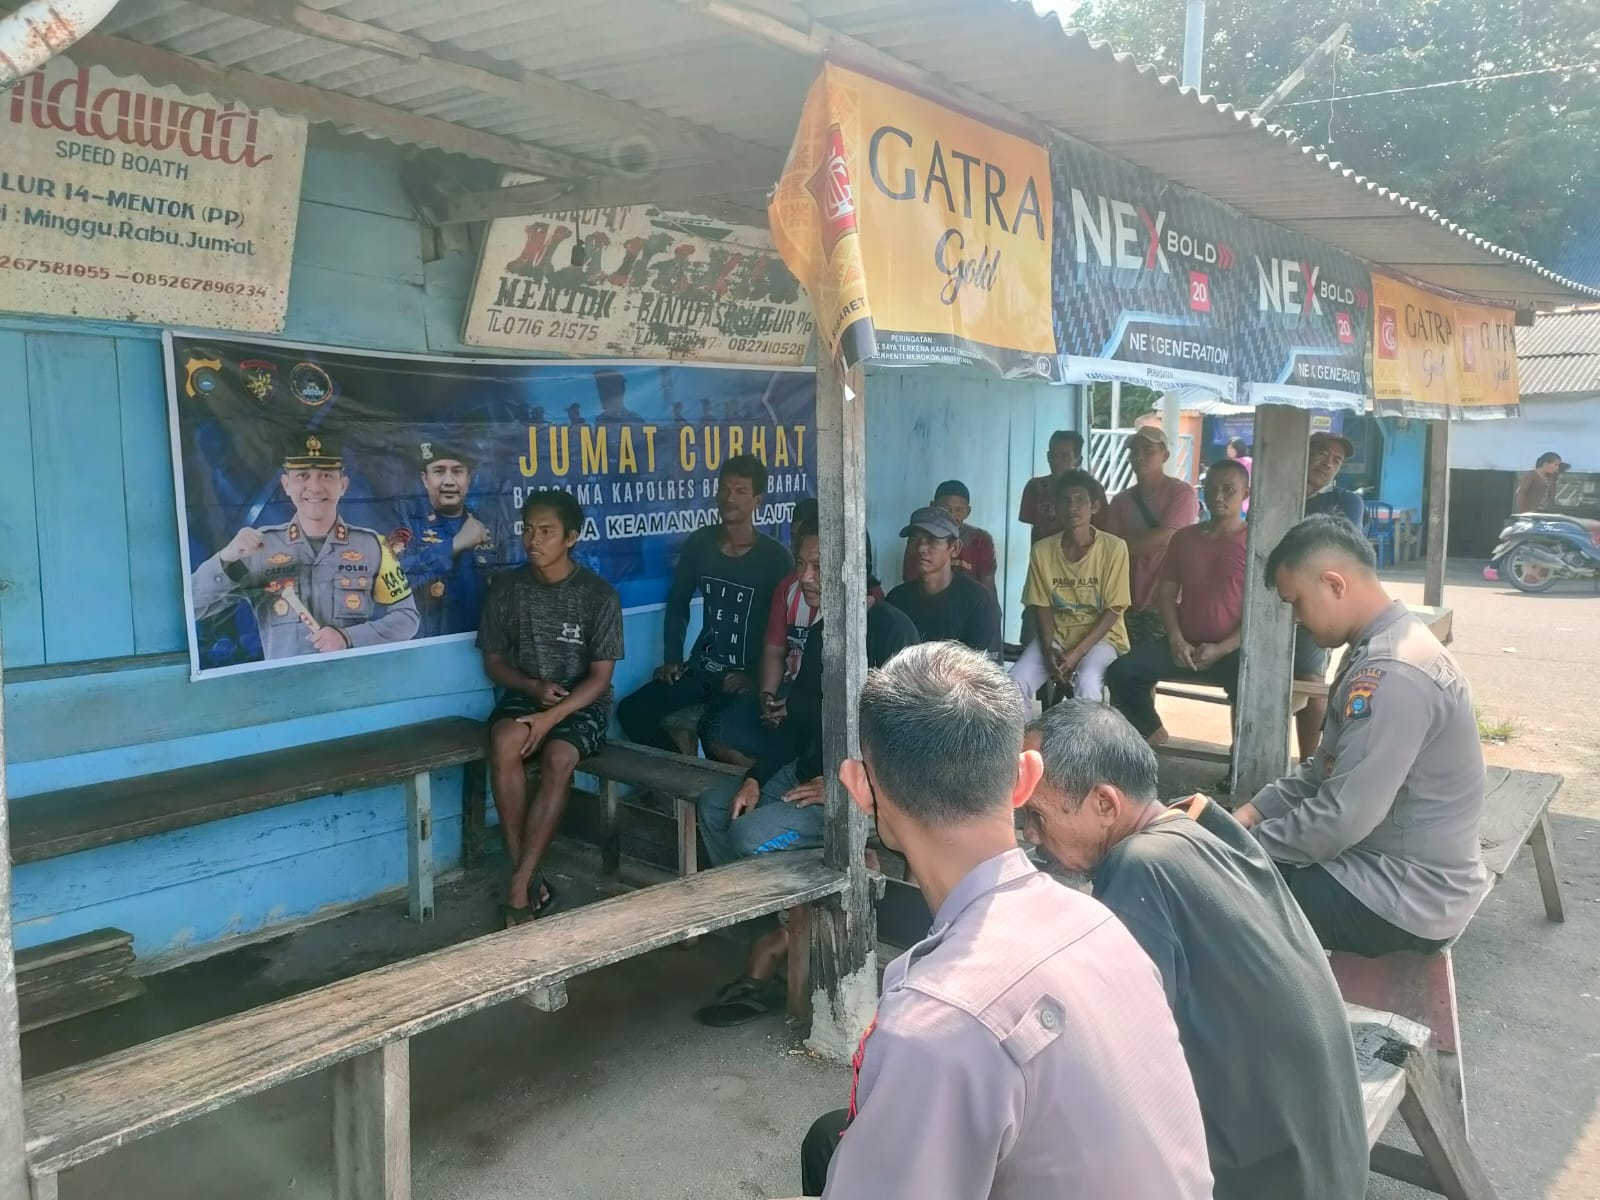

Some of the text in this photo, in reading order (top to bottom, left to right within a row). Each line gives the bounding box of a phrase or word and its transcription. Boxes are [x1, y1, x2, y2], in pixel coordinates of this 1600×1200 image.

[56, 141, 189, 181] SPEED BOATH
[869, 126, 1046, 241] GATRA
[202, 206, 245, 229] (PP)
[1071, 188, 1217, 275] NEX BOLD
[935, 229, 1001, 305] Gold
[1192, 279, 1207, 303] 20
[1256, 255, 1354, 316] NEX BOLD
[548, 320, 600, 342] 21575
[891, 334, 932, 344] PERINGATAN
[1338, 318, 1351, 338] 20
[1405, 304, 1452, 345] GATRA
[881, 343, 898, 351] SAYA
[898, 344, 929, 353] TERKENA
[1156, 336, 1229, 365] GENERATION
[519, 425, 807, 478] JUMAT CURHAT
[612, 478, 695, 504] KAPOLRES
[767, 472, 807, 494] BARAT
[753, 502, 797, 526] LAUT
[338, 564, 368, 573] POLRI
